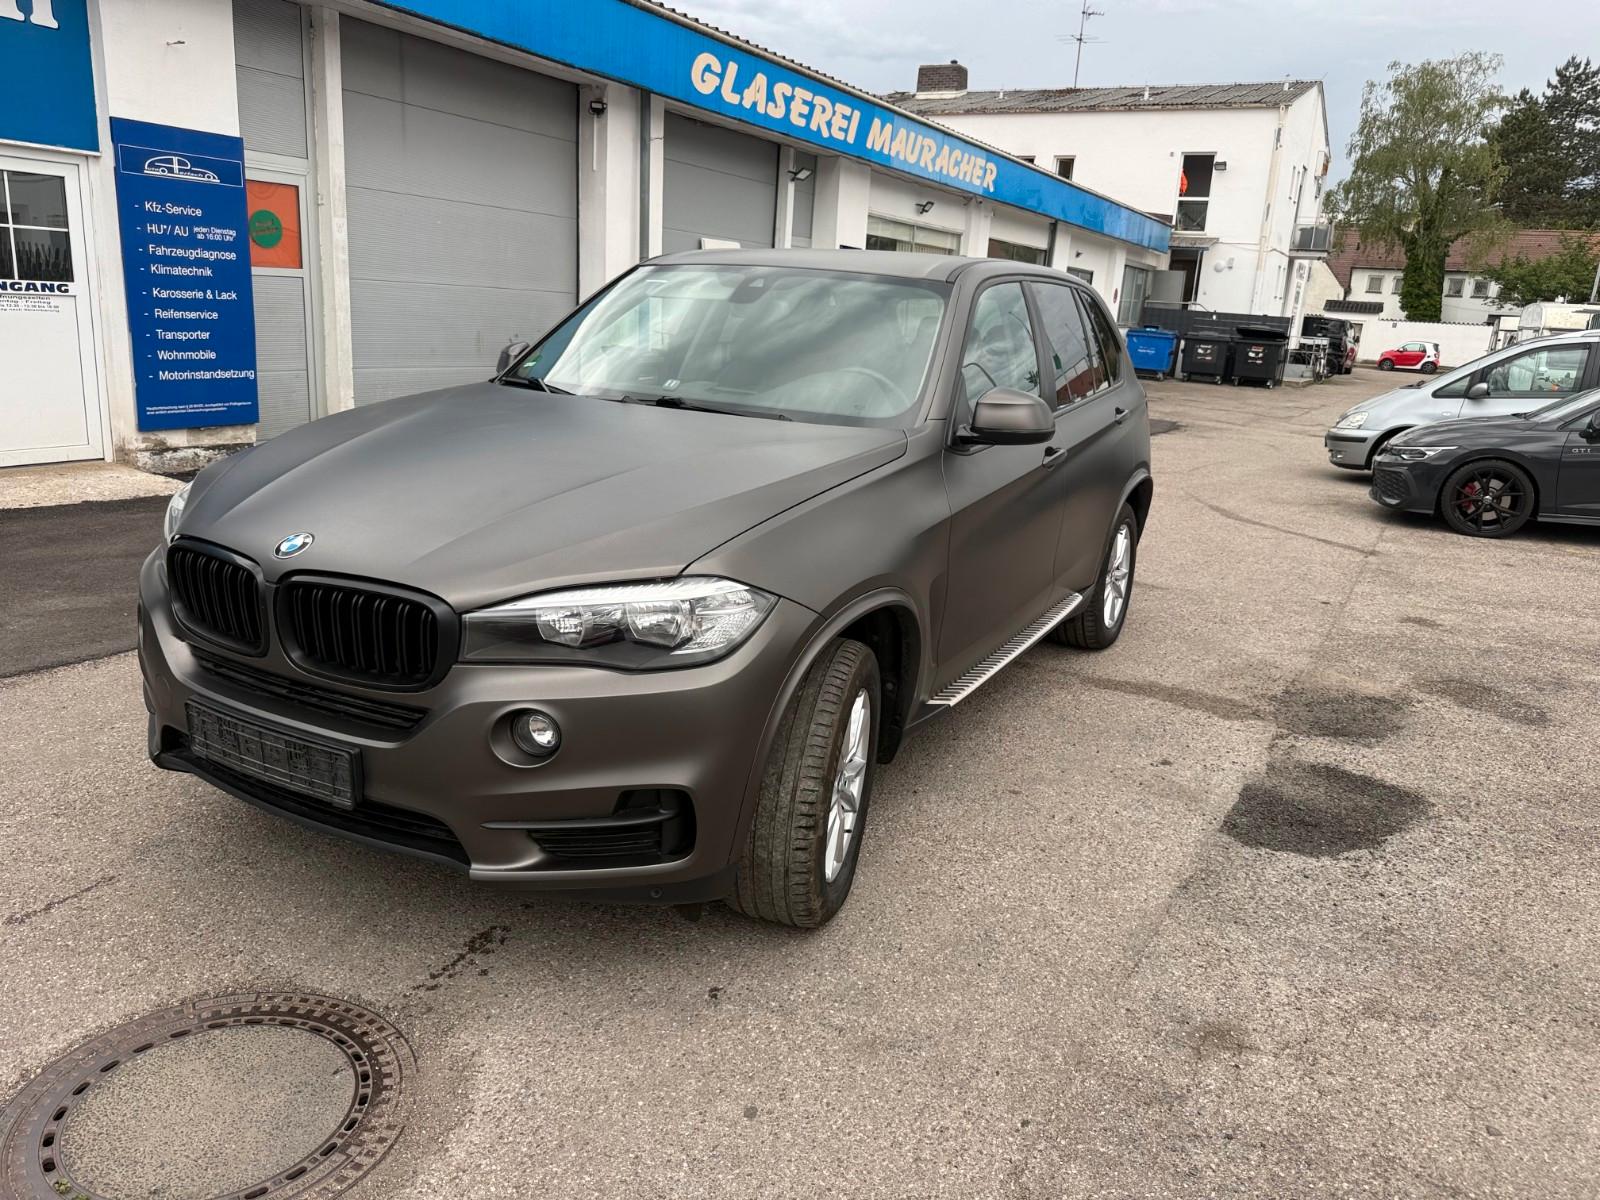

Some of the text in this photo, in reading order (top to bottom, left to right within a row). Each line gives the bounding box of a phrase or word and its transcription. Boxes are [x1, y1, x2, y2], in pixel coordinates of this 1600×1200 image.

[691, 52, 997, 192] GLASEREI MAURACHER
[145, 201, 202, 216] Kfz-Service
[174, 226, 189, 237] AU
[211, 227, 237, 236] Dienstag
[149, 245, 237, 260] Fahrzeugdiagnose
[151, 264, 213, 276] Klimatechnik
[153, 288, 237, 300] Karosserie & Lack
[155, 309, 218, 319] Reifenservice
[156, 329, 210, 341] Transporter
[157, 350, 217, 360] Wohnmobile
[159, 369, 255, 380] Motorinstandsetzung
